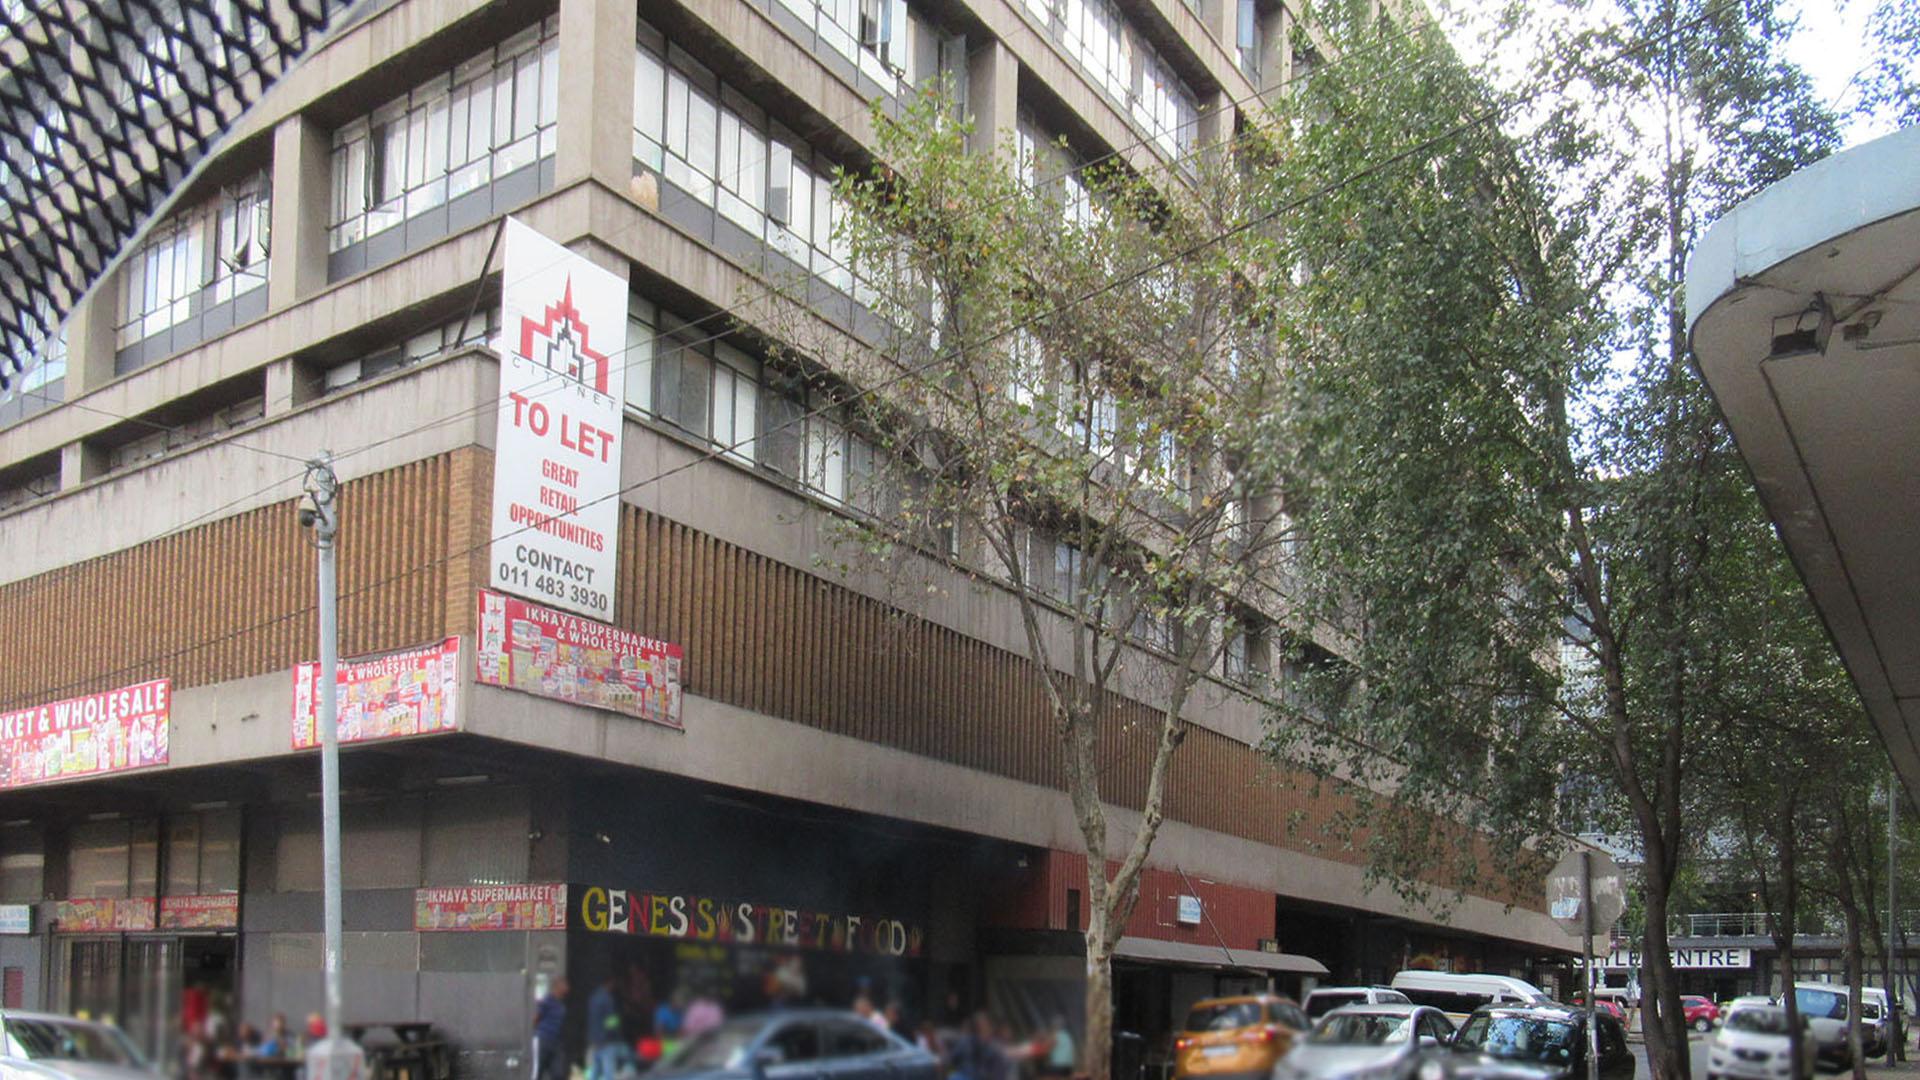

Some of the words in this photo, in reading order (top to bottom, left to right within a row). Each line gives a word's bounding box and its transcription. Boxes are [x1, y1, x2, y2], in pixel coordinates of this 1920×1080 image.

[512, 356, 616, 410] CITYNET
[509, 391, 550, 437] TO
[560, 414, 615, 463] LET
[542, 458, 579, 488] GREAT
[540, 486, 578, 516] RETAIL
[510, 503, 604, 552] OPPORTUNITIES
[500, 562, 528, 587] 011
[535, 574, 565, 598] 483
[570, 584, 607, 611] 3930
[516, 545, 595, 584] CONTACT
[525, 606, 578, 631] IKHAYA
[581, 618, 668, 654] SUPERMARKET
[556, 626, 566, 640] &
[569, 629, 642, 658] WHOLESALE
[347, 670, 355, 681] &
[357, 659, 420, 681] WHOLESALE
[38, 707, 50, 733] &
[55, 682, 166, 730] WHOLESALE
[428, 889, 469, 903] IKHAYA
[470, 886, 552, 903] SUPERMARKET
[581, 886, 717, 940] GENESIS
[736, 902, 830, 949] STREET
[846, 915, 906, 956] FOOD
